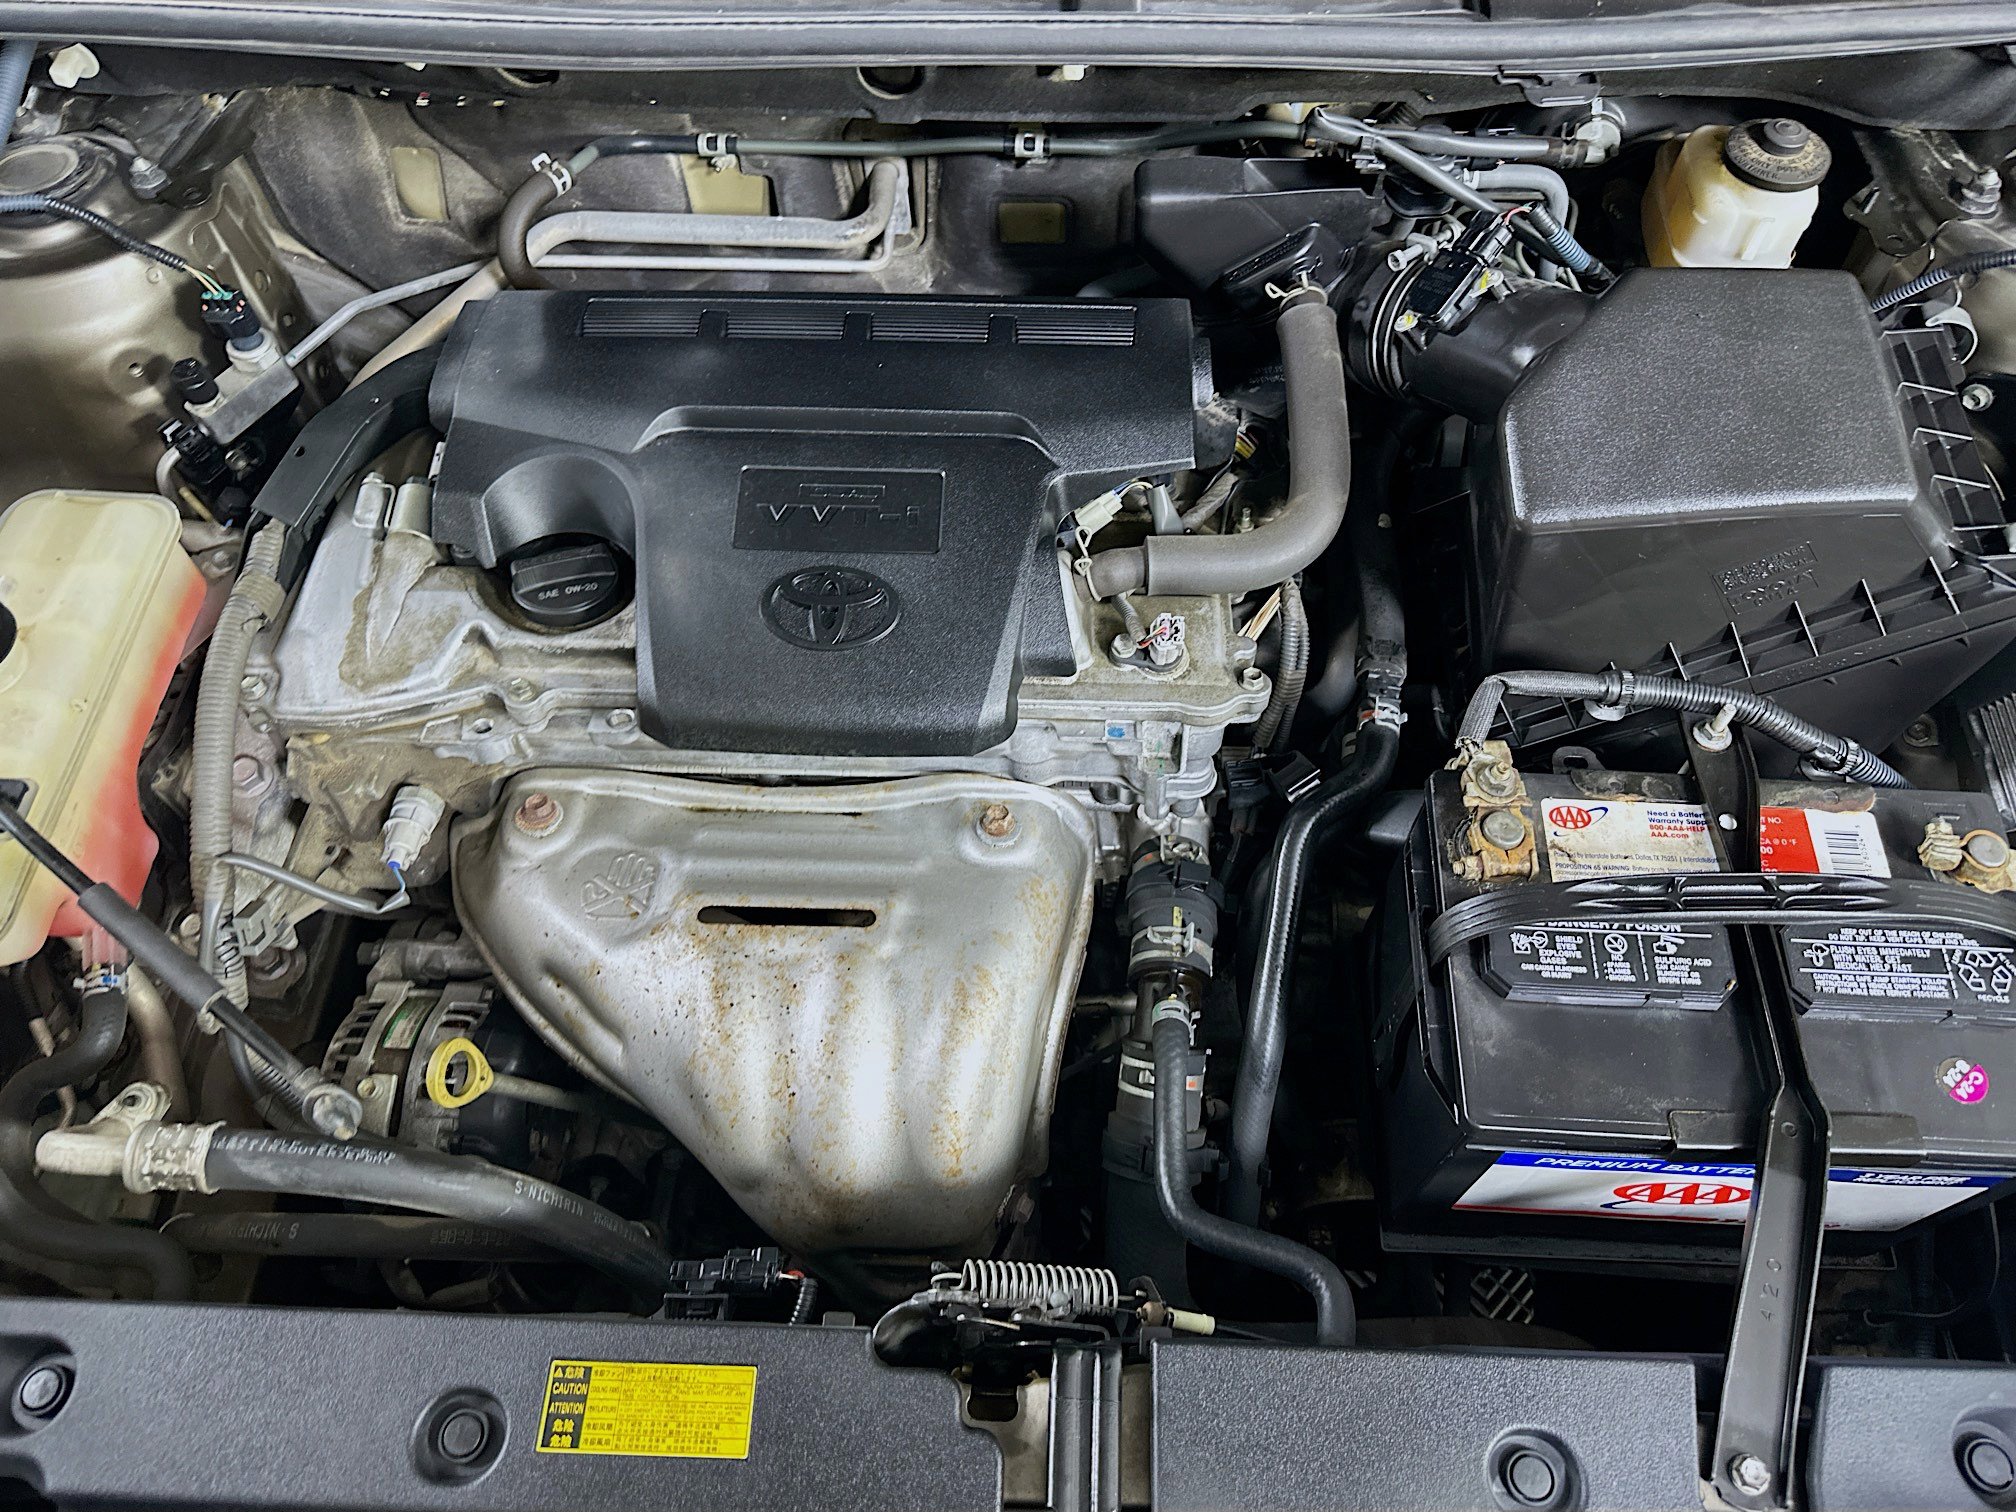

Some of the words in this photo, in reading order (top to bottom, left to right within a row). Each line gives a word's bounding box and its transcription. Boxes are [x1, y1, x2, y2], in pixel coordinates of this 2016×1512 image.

[537, 588, 560, 600] SAE
[565, 582, 598, 594] 0W-20
[1550, 806, 1591, 829] AAA
[1648, 817, 1684, 825] Warranty
[1649, 824, 1706, 832] 800-AAA-HELP
[1650, 831, 1689, 839] AAA.com
[1760, 846, 1773, 854] 00
[1858, 928, 1872, 936] OUT
[1898, 930, 1920, 938] REACH
[1555, 935, 1583, 944] SHIELD
[1555, 942, 1577, 951] EYES
[1830, 945, 1855, 954] FLUSH
[1857, 946, 1878, 955] EYES
[1879, 947, 1930, 958] IMMEDIATELY
[1539, 948, 1582, 959] EXPLOSIVE
[1832, 953, 1853, 962] WITH
[1885, 955, 1901, 964] GET
[1540, 956, 1567, 965] GASES
[1654, 956, 1692, 965] SULFURIC
[1693, 958, 1712, 967] ACID
[1834, 962, 1869, 971] MEDICAL
[1870, 963, 1890, 972] HELP
[1892, 964, 1912, 973] FAST
[1815, 980, 1859, 988] INSTRUCTIONS
[1977, 994, 2010, 1004] RECYCLE
[1534, 1157, 1660, 1170] PREMIUM
[1660, 1164, 1756, 1175] BATTER
[1613, 1182, 1751, 1205] AAA
[552, 1382, 588, 1395] CAUTION
[549, 1402, 585, 1415] ATTENTION
